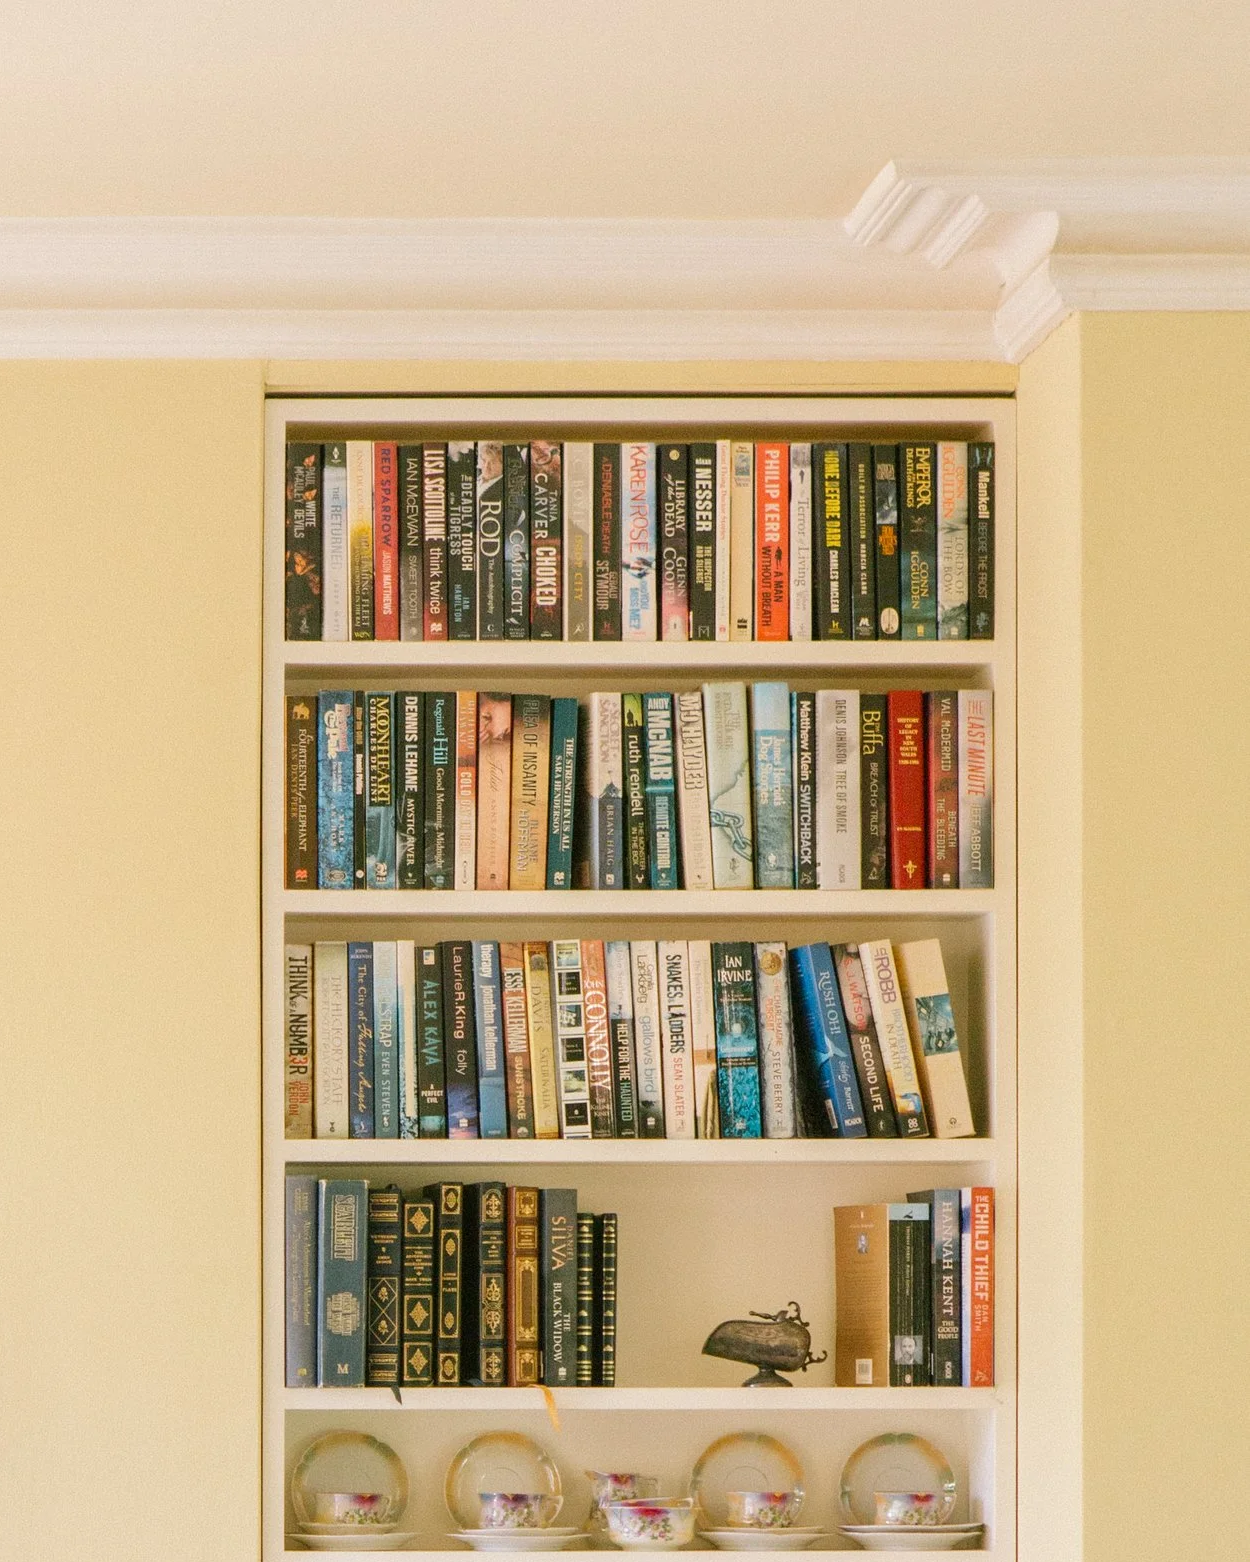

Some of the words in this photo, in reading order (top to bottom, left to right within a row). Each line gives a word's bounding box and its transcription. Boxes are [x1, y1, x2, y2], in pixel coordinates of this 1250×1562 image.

[381, 448, 391, 474] RED
[424, 450, 444, 475] LISA
[629, 445, 647, 501] KAREN
[764, 450, 779, 498] PHILIP
[915, 448, 931, 508] EMPEROR
[306, 501, 316, 527] WHITE
[381, 479, 391, 546] SPARROW
[425, 478, 445, 541] SCOTTOLINE
[535, 473, 548, 539] CARVER
[549, 491, 558, 521] TANIA
[675, 480, 685, 530] LIBRARY
[695, 468, 712, 531] NESSER
[978, 471, 989, 518] Mankell
[450, 506, 461, 555] TIGRESS
[480, 500, 501, 556] ROD
[629, 505, 648, 552] ROSE
[765, 503, 780, 542] KERR
[429, 548, 442, 577] think
[536, 547, 557, 605] CHOKED
[761, 546, 771, 589] WITHOUT
[911, 551, 919, 609] IGGULDEN
[920, 562, 929, 597] CONN
[430, 581, 441, 614] twice
[596, 560, 609, 610] SEYMOUR
[762, 592, 771, 626] BREATH
[405, 696, 418, 741] DENNIS
[434, 699, 445, 735] Reginald
[800, 701, 811, 750] Matthew
[836, 700, 846, 724] DENIS
[967, 716, 985, 746] LAST
[376, 697, 390, 804] MOONHEART
[433, 738, 449, 766] Hill
[566, 738, 574, 757] THE
[628, 735, 641, 763] ruth
[648, 710, 672, 780] McNAB
[836, 725, 847, 765] JOHNSON
[862, 710, 883, 755] Buffa
[370, 756, 377, 771] DE
[405, 745, 418, 792] LEHANE
[554, 755, 562, 778] SARA
[563, 759, 573, 806] STRENGTH
[801, 752, 811, 781] Klein
[836, 770, 846, 789] TREE
[967, 748, 985, 798] MINUTE
[552, 781, 561, 834] HENDERSON
[630, 768, 643, 816] rendell
[836, 792, 846, 803] OF
[937, 798, 945, 813] THE
[562, 820, 570, 831] US
[563, 808, 571, 818] IN
[606, 805, 614, 835] BRIAN
[800, 785, 811, 864] SWITCHBACK
[836, 805, 847, 833] SMOKE
[948, 811, 956, 848] BENEATH
[562, 833, 570, 851] ALL
[936, 819, 946, 860] BLEEDING
[480, 944, 494, 978] therapy
[666, 954, 683, 999] SNAKES
[423, 980, 440, 1020] ALEX
[480, 985, 496, 1024] jonathan
[530, 985, 544, 1033] DAVIS
[818, 971, 834, 1008] RUSH
[826, 1009, 841, 1034] OH!
[421, 1027, 442, 1065] KAVA
[484, 1026, 498, 1071] kellerman
[584, 990, 611, 1091] CONNOLLY
[617, 1023, 629, 1045] HELP
[640, 1016, 655, 1065] gallows
[381, 1051, 390, 1075] EVEN
[455, 1050, 468, 1075] folly
[618, 1047, 630, 1063] FOR
[618, 1065, 631, 1080] THE
[673, 1058, 682, 1081] SEAN
[772, 1051, 781, 1081] STEVE
[859, 1035, 878, 1084] SECOND
[869, 1086, 883, 1112] LIFE
[382, 1080, 390, 1115] STEVEN
[515, 1056, 527, 1120] SUNSTROKE
[644, 1068, 657, 1093] bird
[675, 1085, 684, 1116] SLATER
[774, 1083, 783, 1114] BERRY
[620, 1082, 632, 1121] HAUNTED
[334, 1195, 355, 1261] SCARLETT
[551, 1216, 566, 1270] SILVA
[566, 1225, 574, 1261] DANIEL
[942, 1202, 953, 1269] HANNAH
[975, 1203, 989, 1251] CHILD
[942, 1275, 954, 1316] KENT
[975, 1255, 989, 1301] THIEF
[553, 1282, 562, 1317] BLACK
[553, 1320, 562, 1363] WIDOW
